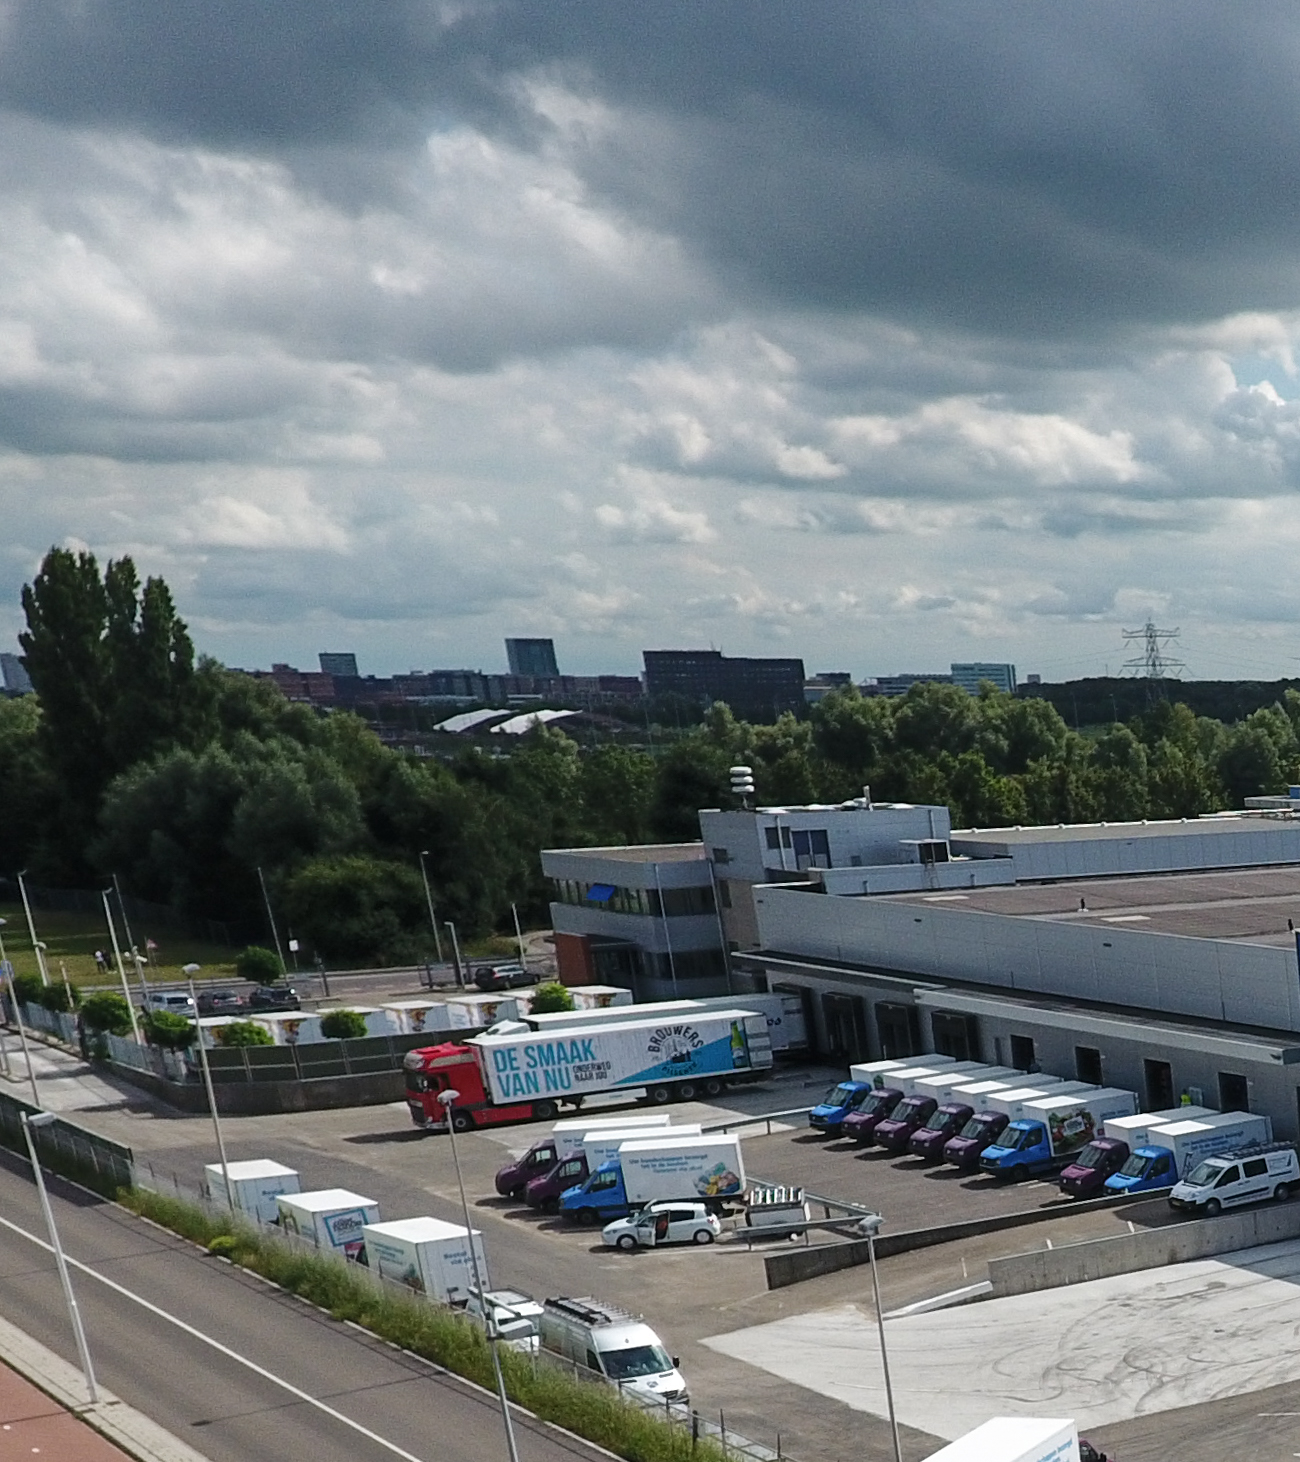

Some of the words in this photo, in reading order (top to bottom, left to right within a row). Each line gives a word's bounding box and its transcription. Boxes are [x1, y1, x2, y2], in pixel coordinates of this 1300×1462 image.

[493, 1047, 518, 1072] DE
[526, 1038, 596, 1070] SMAAK
[647, 1025, 704, 1053] BROUWERS
[497, 1069, 540, 1098] VAN
[545, 1066, 571, 1091] NU
